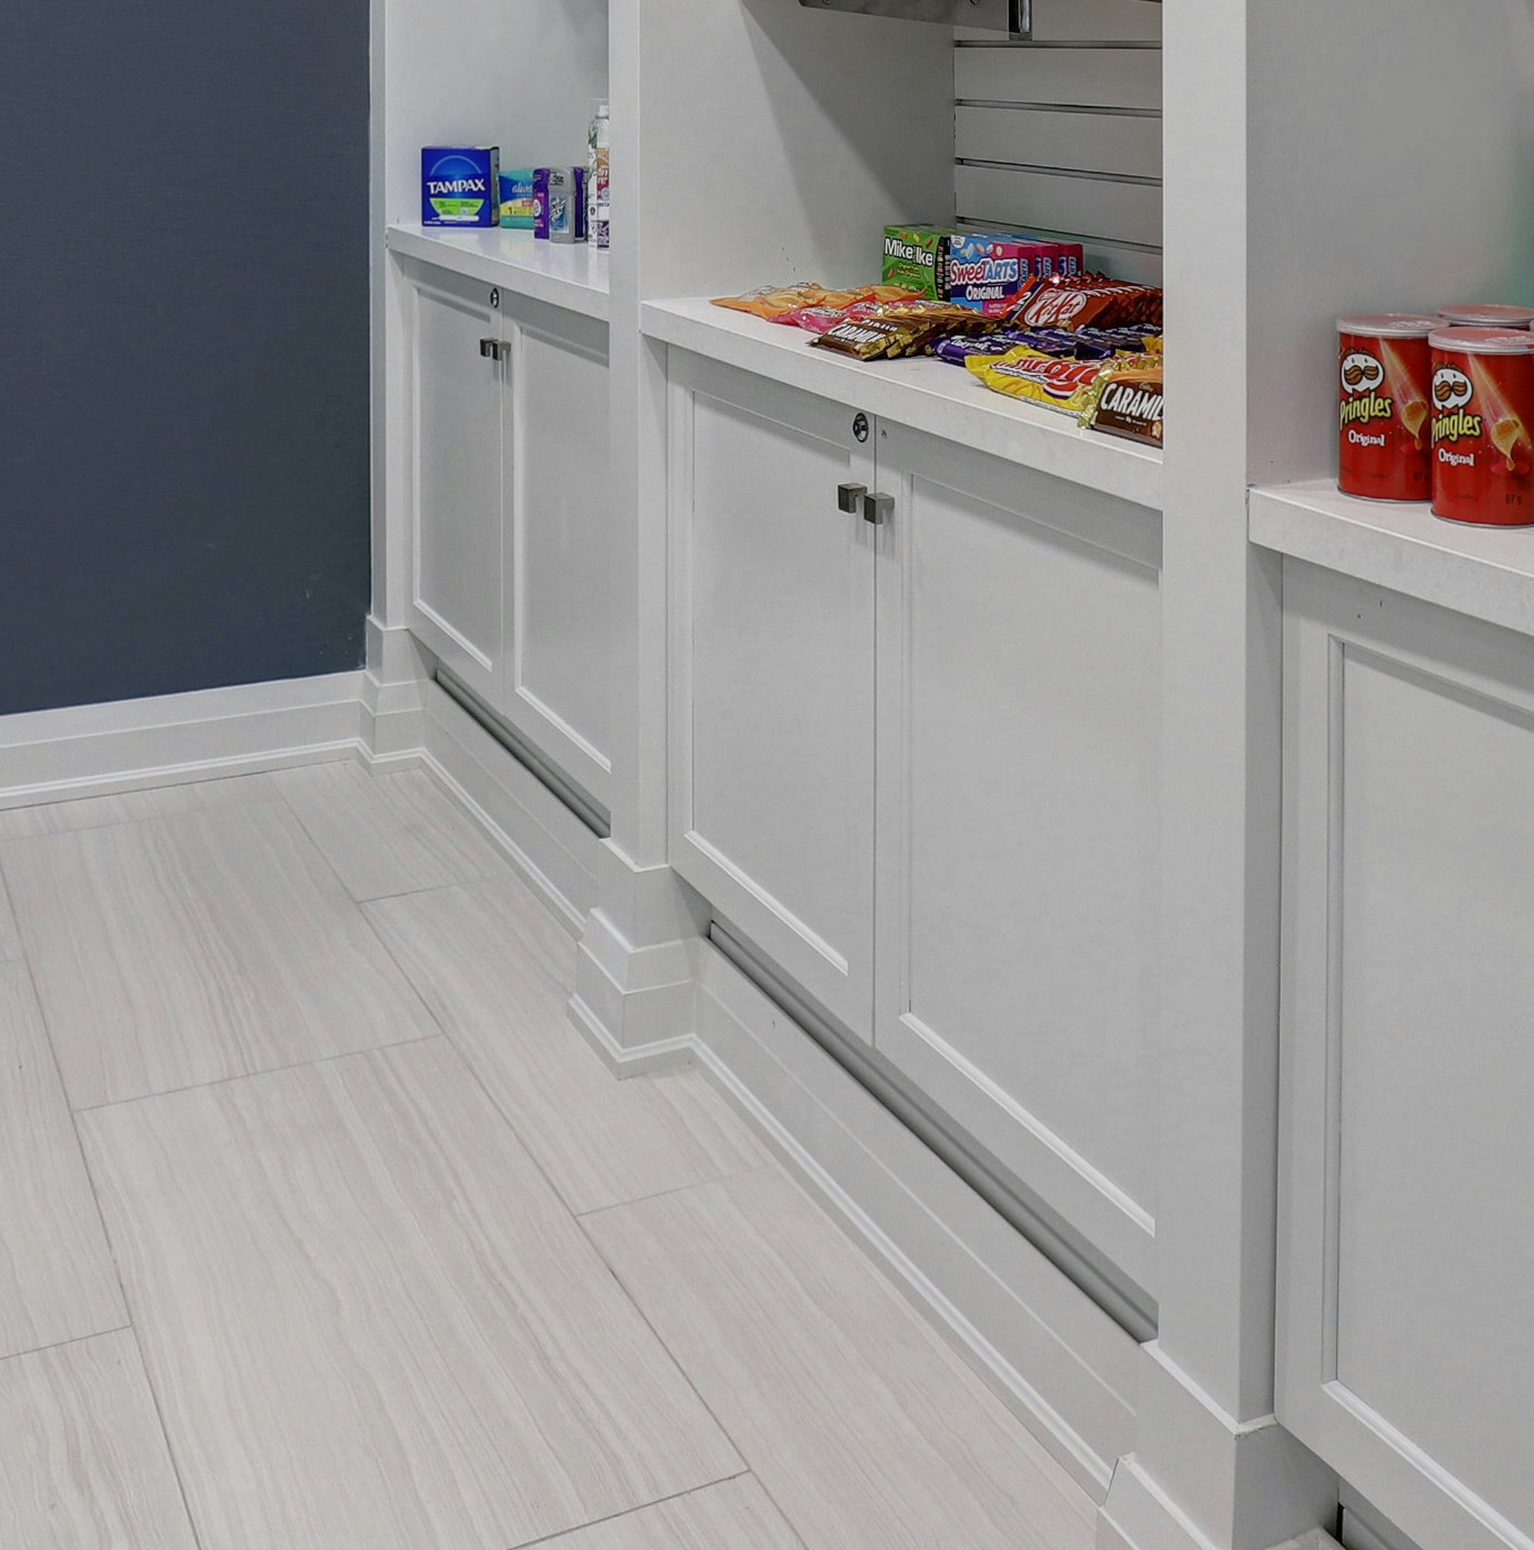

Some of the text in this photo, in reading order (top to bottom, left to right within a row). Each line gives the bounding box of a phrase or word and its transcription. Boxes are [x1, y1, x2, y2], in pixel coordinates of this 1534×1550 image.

[427, 178, 486, 194] TAMPAX
[884, 237, 933, 267] Mike Ike
[950, 257, 1018, 286] SweeTARTS
[966, 285, 1005, 301] ORIGINAL
[1339, 391, 1392, 432] Pringles
[1348, 430, 1385, 447] Original
[1438, 448, 1475, 467] Original
